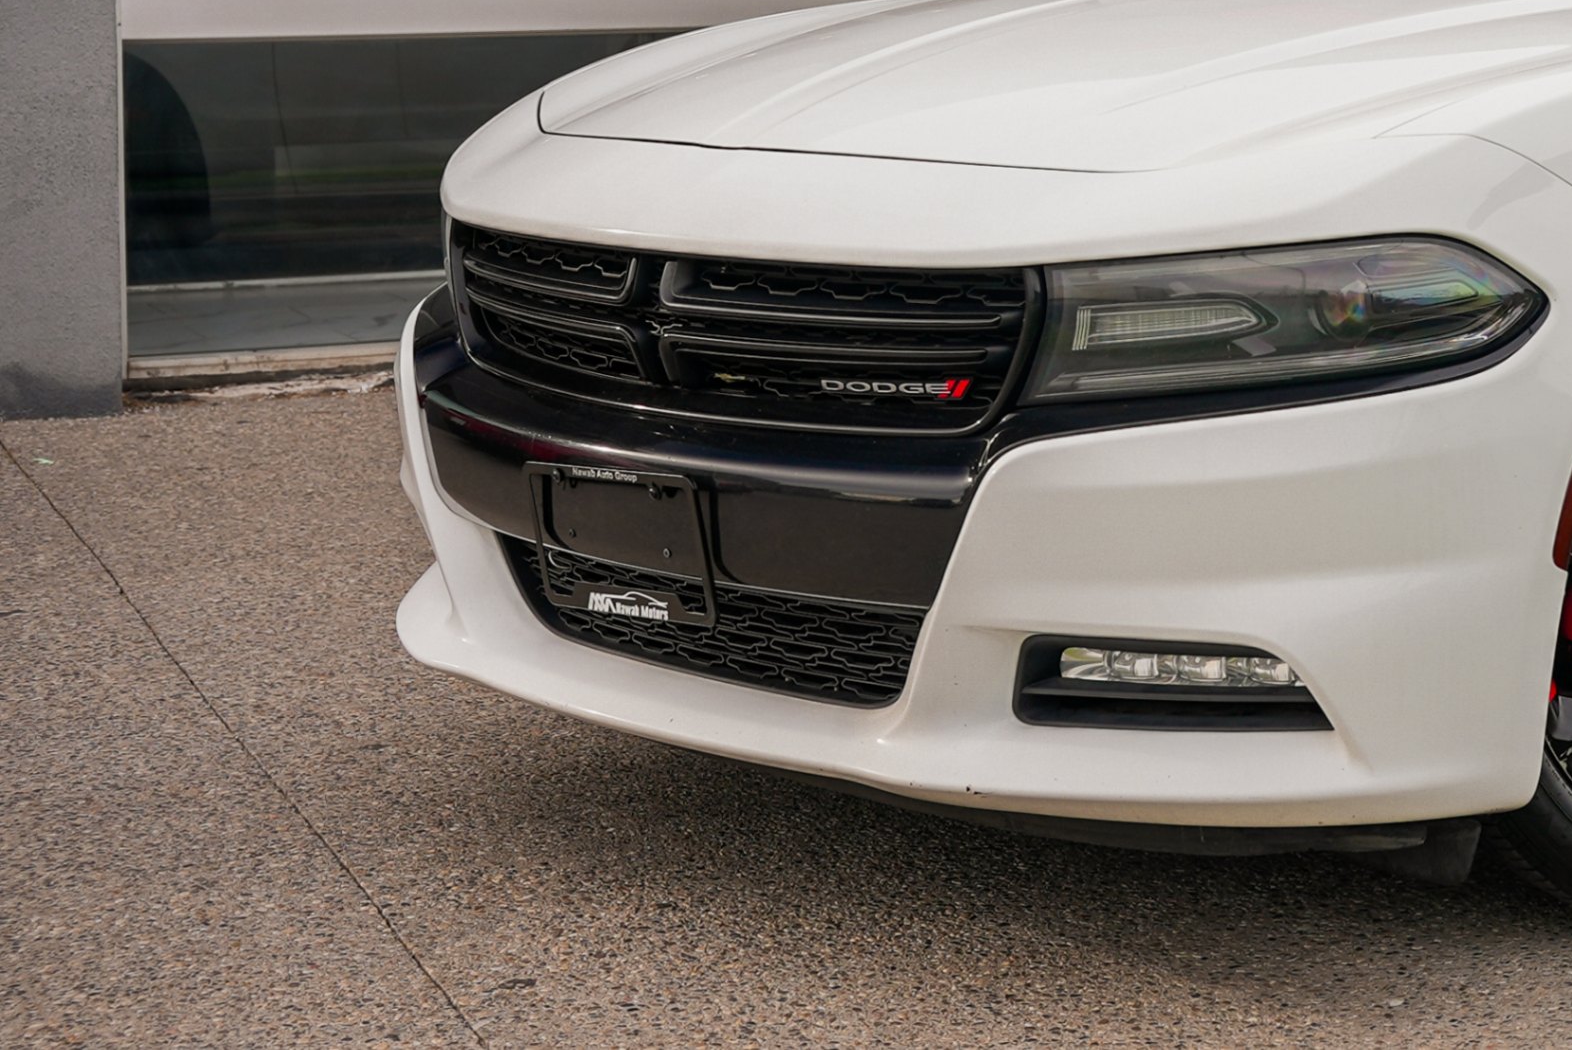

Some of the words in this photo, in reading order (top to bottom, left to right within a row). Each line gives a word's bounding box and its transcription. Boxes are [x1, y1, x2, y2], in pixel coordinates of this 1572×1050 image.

[821, 379, 951, 394] DODGE
[572, 467, 596, 478] Nawab
[596, 468, 614, 479] Auto
[614, 471, 638, 483] Group
[616, 602, 640, 617] Nawab
[641, 604, 669, 622] Motors
